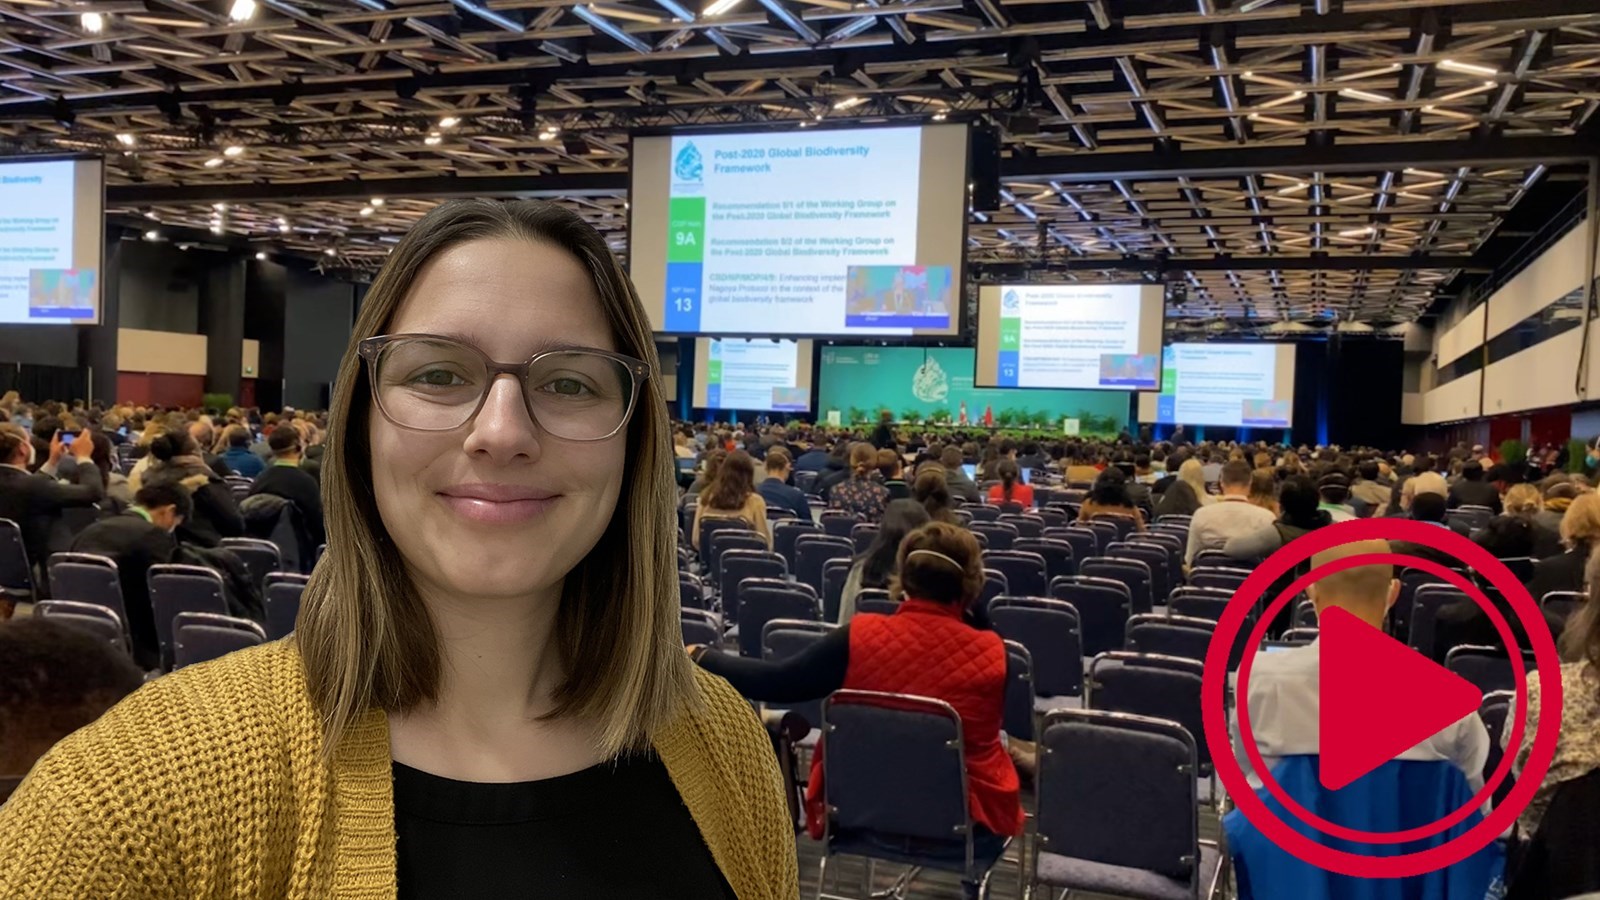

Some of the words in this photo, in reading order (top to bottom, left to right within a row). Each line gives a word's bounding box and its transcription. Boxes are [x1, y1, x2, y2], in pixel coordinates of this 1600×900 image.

[714, 148, 765, 159] Post-2020
[768, 147, 802, 158] Global
[805, 145, 870, 157] Biodiversity
[714, 163, 771, 173] Framework
[820, 200, 855, 210] Working
[857, 199, 883, 209] Group
[675, 231, 696, 246] 9A
[855, 236, 881, 246] Group
[674, 297, 692, 312] 13
